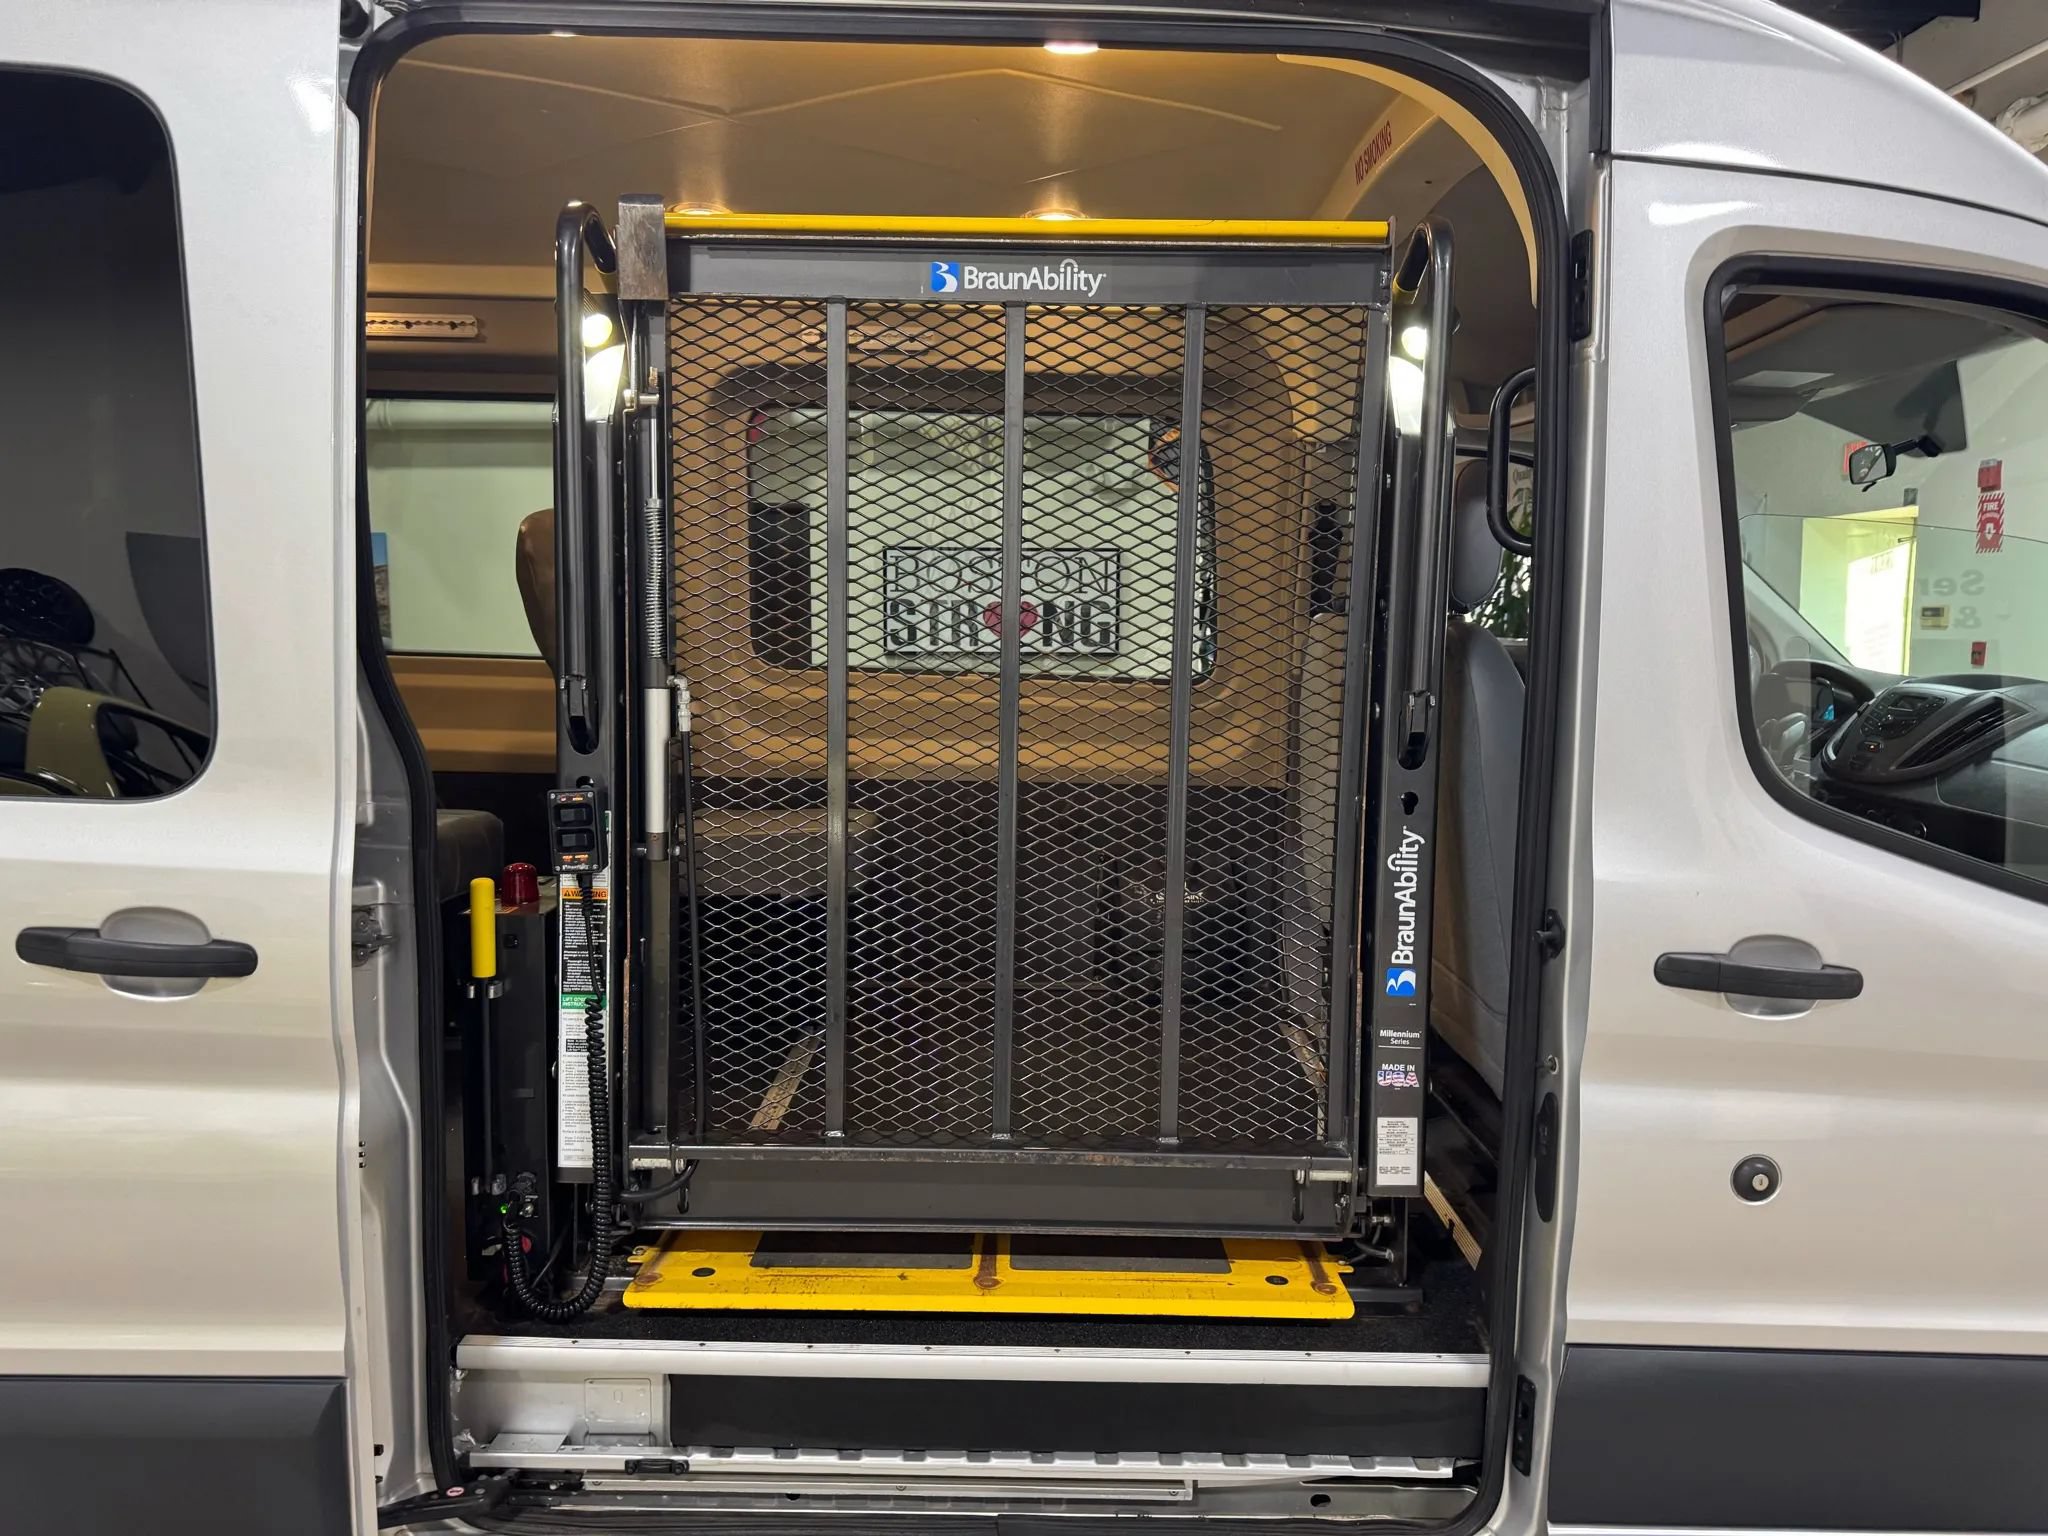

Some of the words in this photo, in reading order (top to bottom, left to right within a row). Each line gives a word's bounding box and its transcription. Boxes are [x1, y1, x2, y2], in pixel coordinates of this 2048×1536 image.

[1354, 155, 1364, 185] NO
[1364, 119, 1393, 175] SMOKING
[963, 258, 1104, 298] BraunAbility
[1983, 501, 2000, 512] FIRE
[888, 554, 1109, 594] BOSON
[571, 889, 607, 898] WING
[1387, 827, 1426, 965] BraunAbility
[1379, 1029, 1421, 1039] Millennium
[1390, 1037, 1410, 1045] Series
[1381, 1063, 1406, 1071] MADE
[1406, 1064, 1416, 1072] IN
[1376, 1070, 1420, 1088] USA
